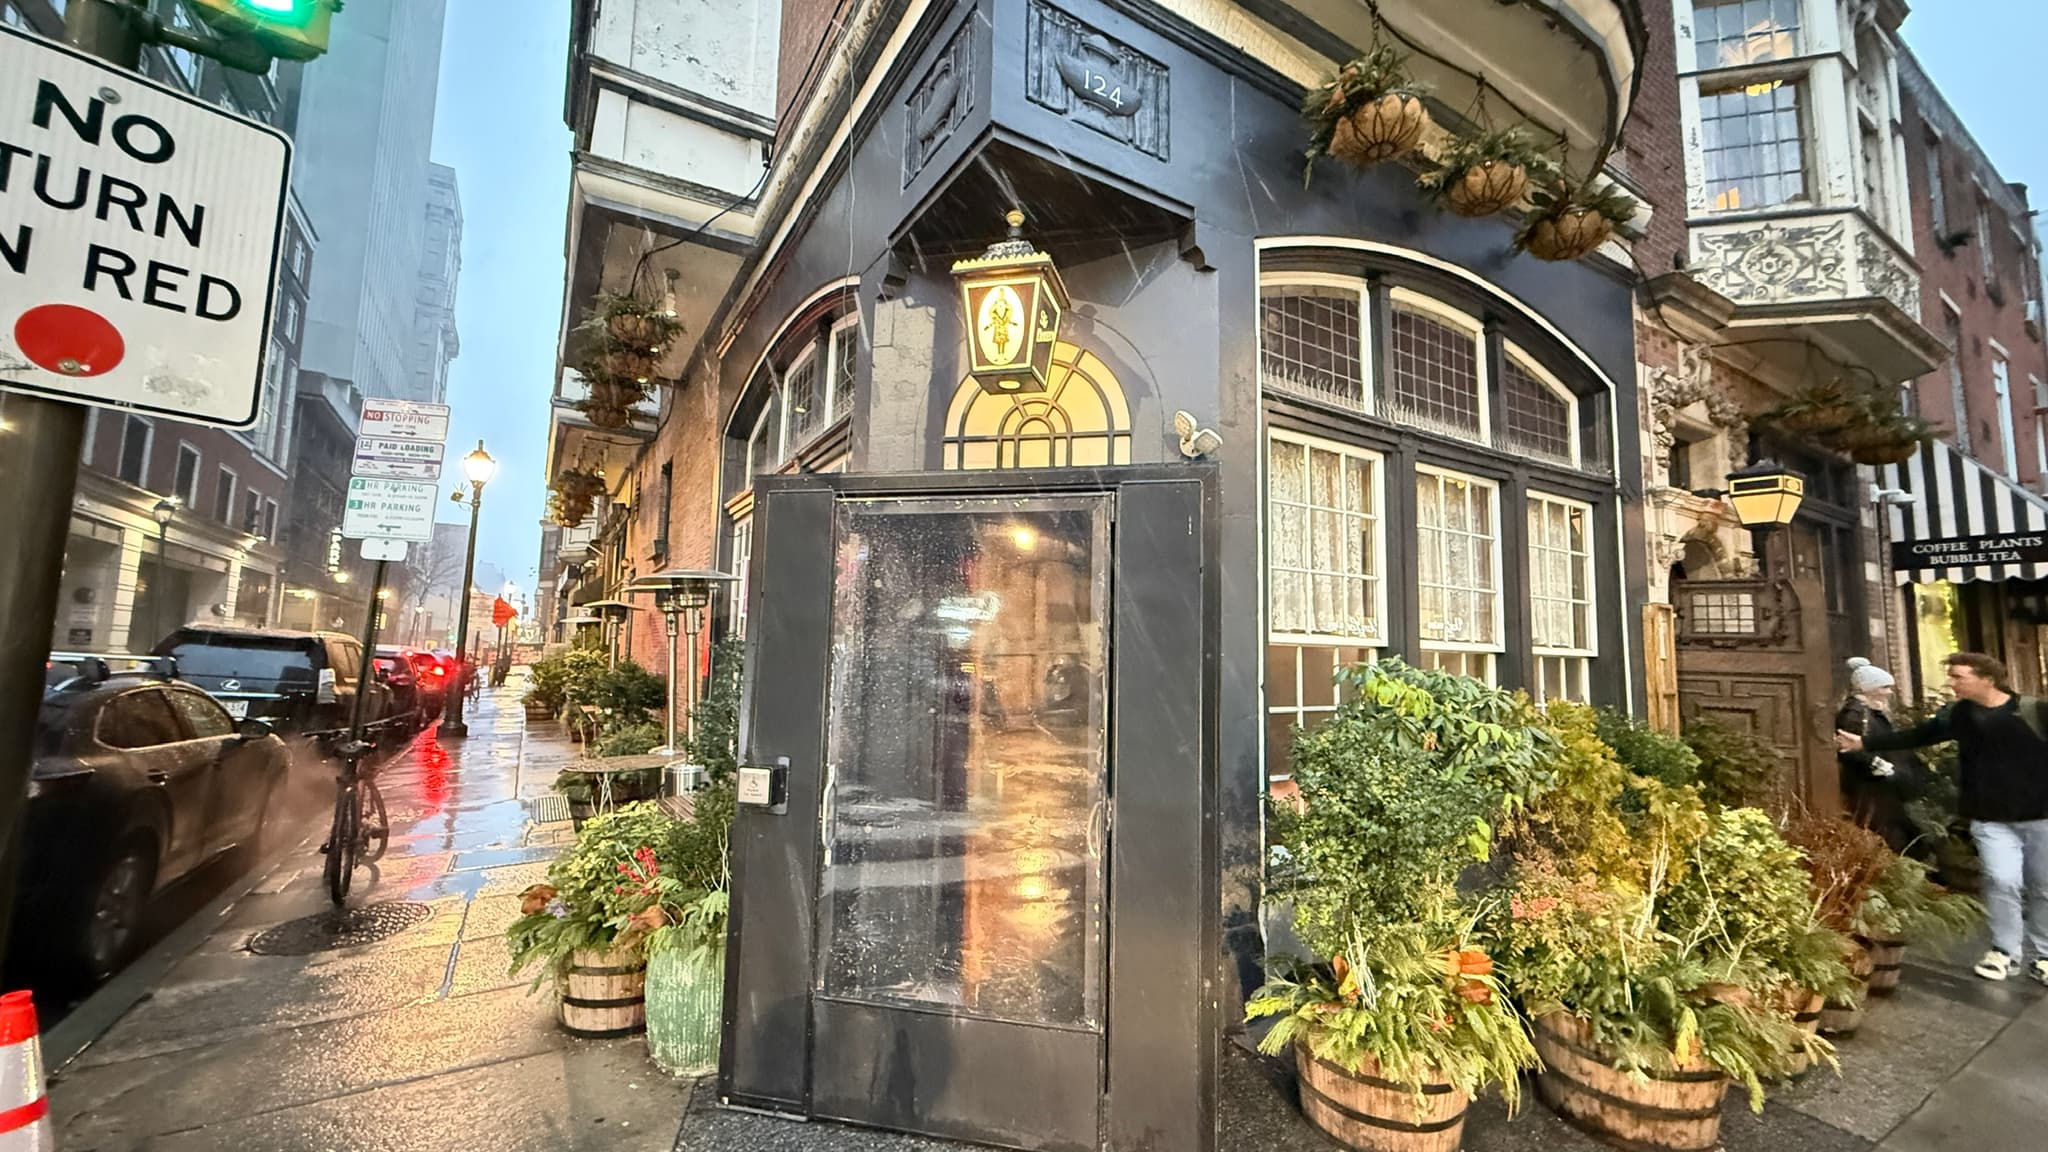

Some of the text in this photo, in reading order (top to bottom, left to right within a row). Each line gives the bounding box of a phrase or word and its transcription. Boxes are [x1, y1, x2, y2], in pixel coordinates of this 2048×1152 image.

[1084, 69, 1124, 109] 124
[32, 78, 176, 164] NO
[0, 141, 205, 248] TURN
[0, 223, 242, 322] N RED
[366, 410, 430, 425] NO STOPPING
[378, 442, 398, 450] PAID
[400, 443, 435, 453] LOADING
[355, 480, 424, 493] 2 HR PARKING
[363, 501, 377, 510] HR
[380, 502, 422, 513] PARKING
[1912, 536, 2043, 554] COFFEE PLANTS
[1929, 551, 2022, 565] BUBBLE TEA
